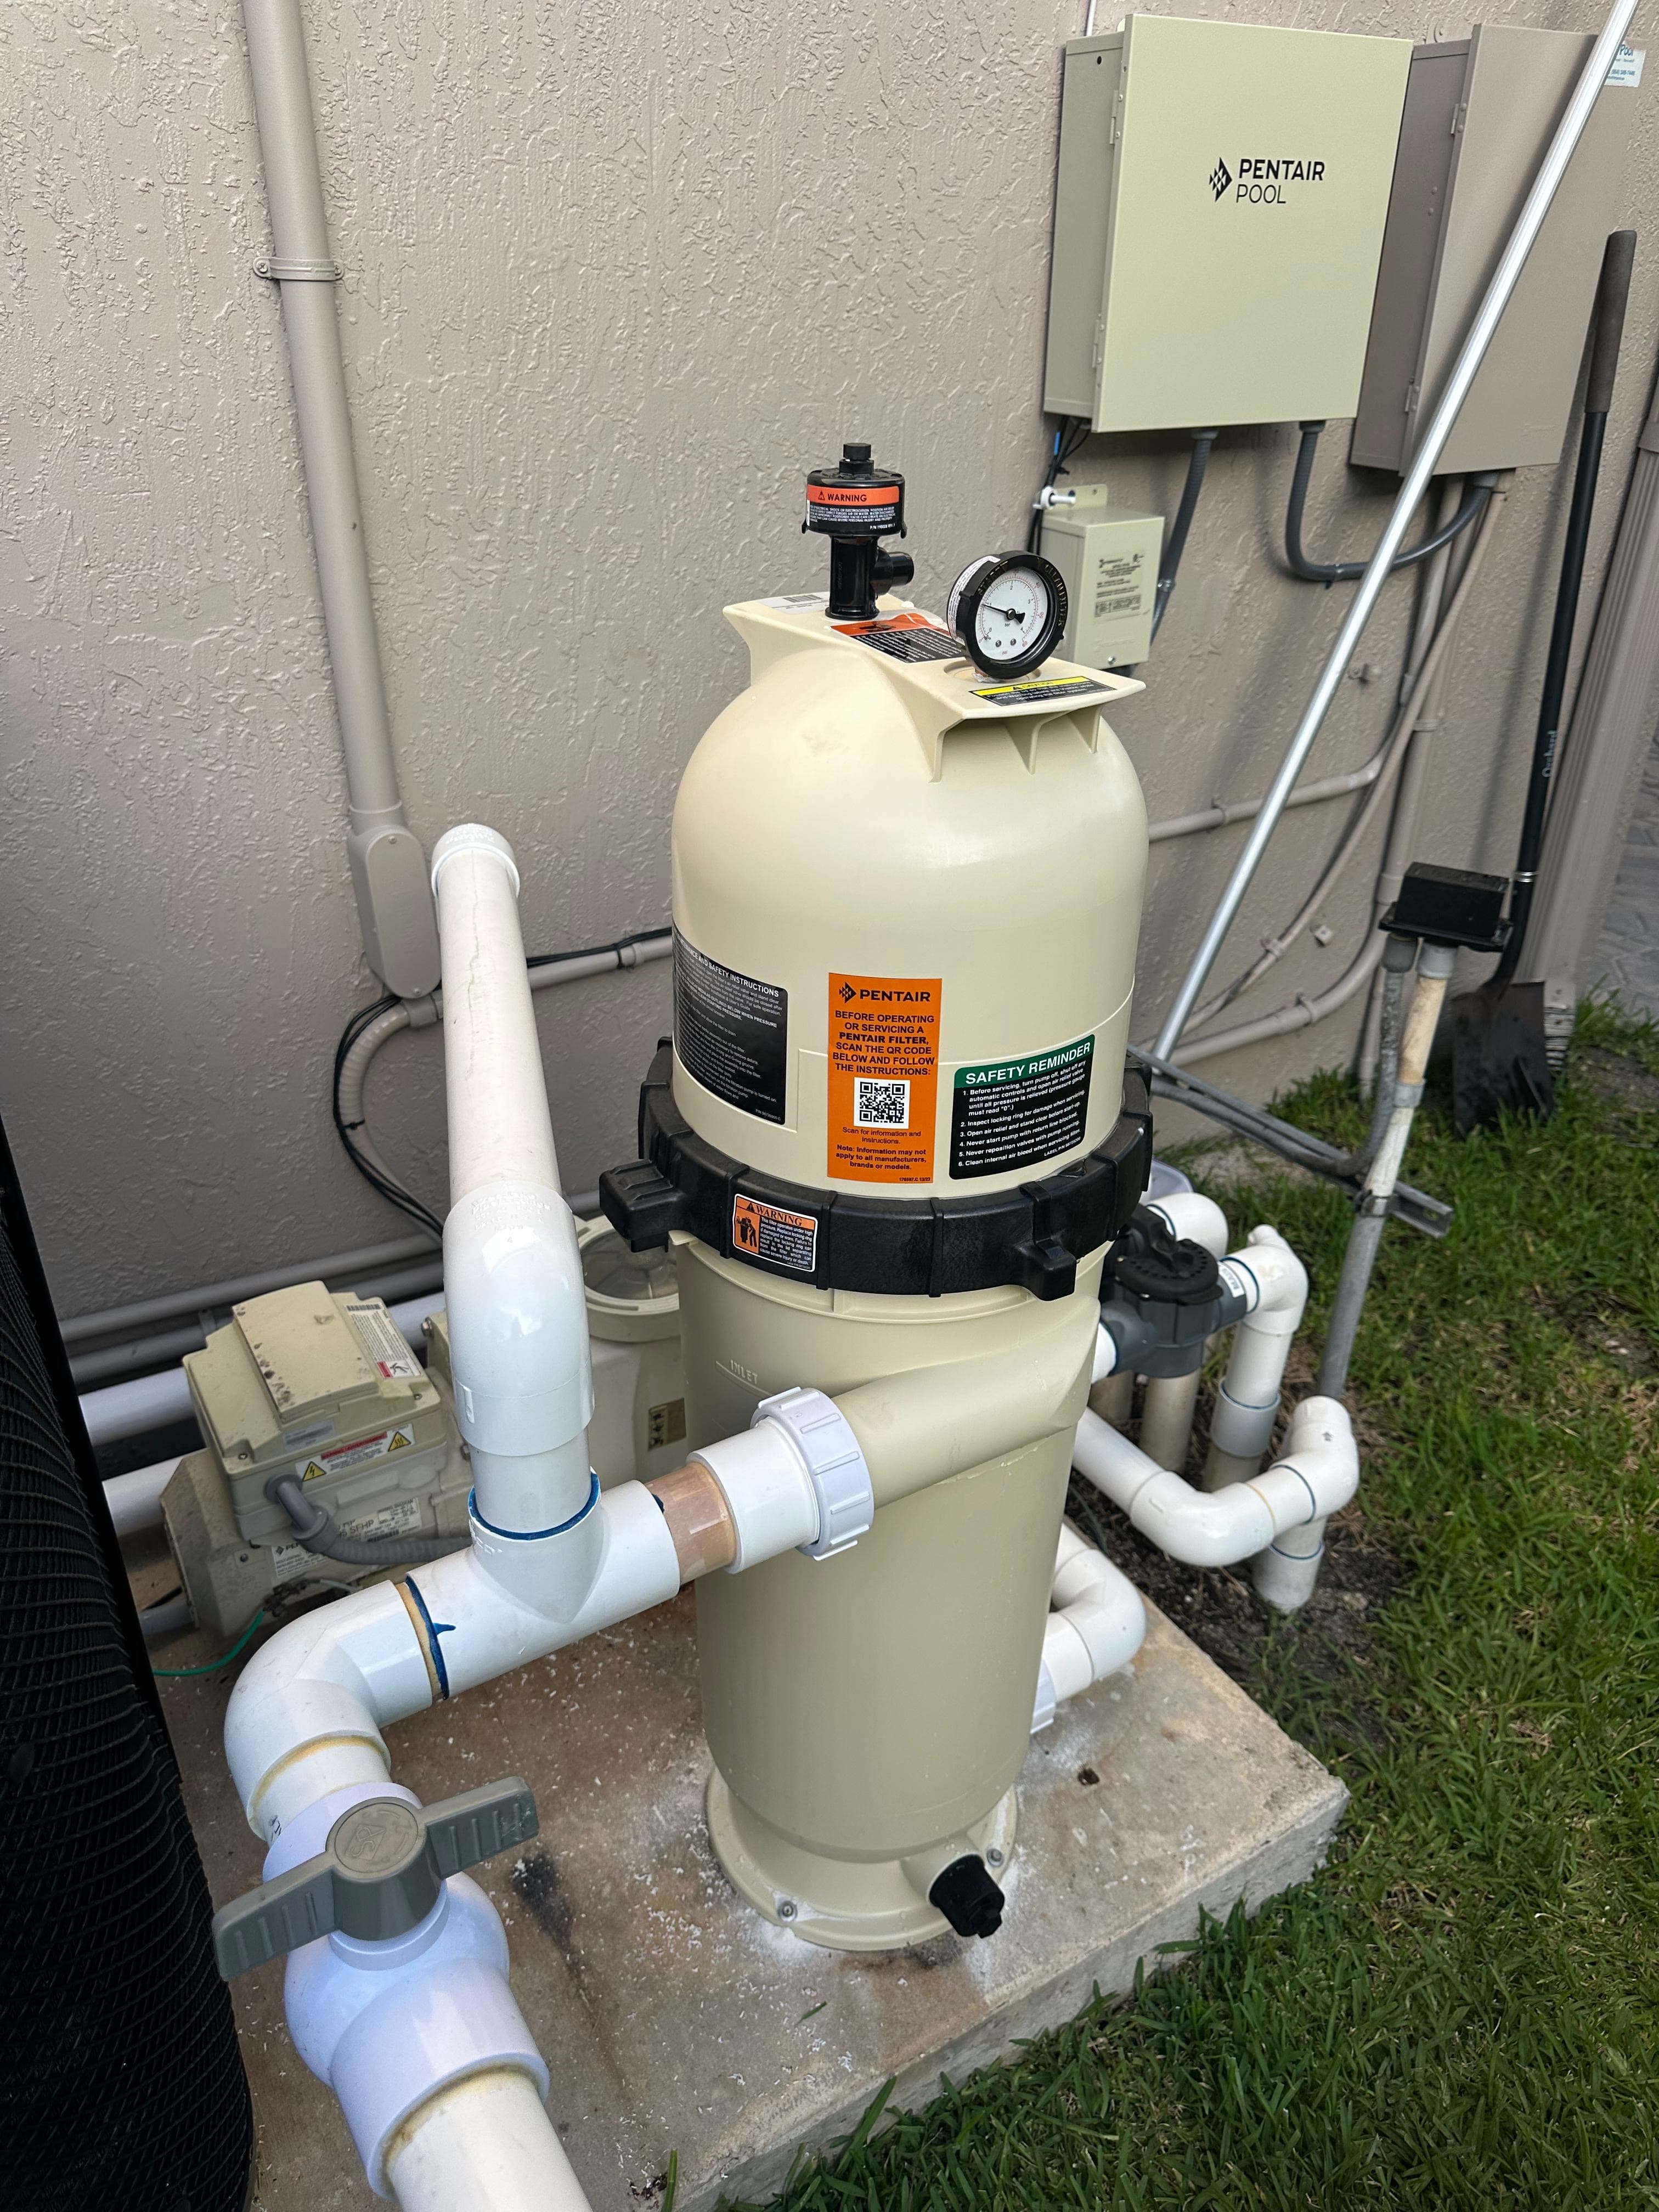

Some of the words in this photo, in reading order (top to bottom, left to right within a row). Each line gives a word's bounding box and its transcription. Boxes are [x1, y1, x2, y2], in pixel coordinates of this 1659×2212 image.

[1239, 159, 1325, 180] PENTAIR
[1237, 184, 1286, 204] POOL
[699, 956, 708, 966] AND
[709, 962, 729, 978] SAFETY
[730, 973, 779, 997] INSTRUCTIONS
[860, 989, 930, 1002] PENTAIR
[836, 1011, 874, 1021] BEFORE
[877, 1014, 934, 1023] OPERATING
[845, 1022, 859, 1030] OR
[862, 1024, 915, 1033] SERVICING
[839, 1032, 885, 1043] PENTAIR
[889, 1036, 928, 1045] FILTER,
[836, 1042, 862, 1052] SCAN
[865, 1045, 884, 1053] THE
[833, 1052, 868, 1063] BELOW
[966, 1065, 1025, 1084] SAFETY
[1029, 1042, 1090, 1074] REMINDER
[836, 1063, 854, 1071] THE
[856, 1065, 930, 1075] INSTRUCTIONS:
[992, 1084, 1020, 1092] servicing,
[1035, 1075, 1050, 1084] pump
[969, 1094, 1000, 1102] automatic
[1002, 1089, 1025, 1097] controls
[994, 1097, 1019, 1107] pressure
[1027, 1089, 1047, 1099] relieved
[1033, 1104, 1052, 1114] damage
[1020, 1119, 1035, 1127] stand
[1002, 1133, 1018, 1142] pump
[1032, 1125, 1048, 1133] return
[986, 1144, 1015, 1153] reposition
[1047, 1129, 1061, 1138] pump
[985, 1154, 1007, 1163] internal
[756, 1205, 803, 1226] WARNING
[731, 1360, 758, 1384] INLET
